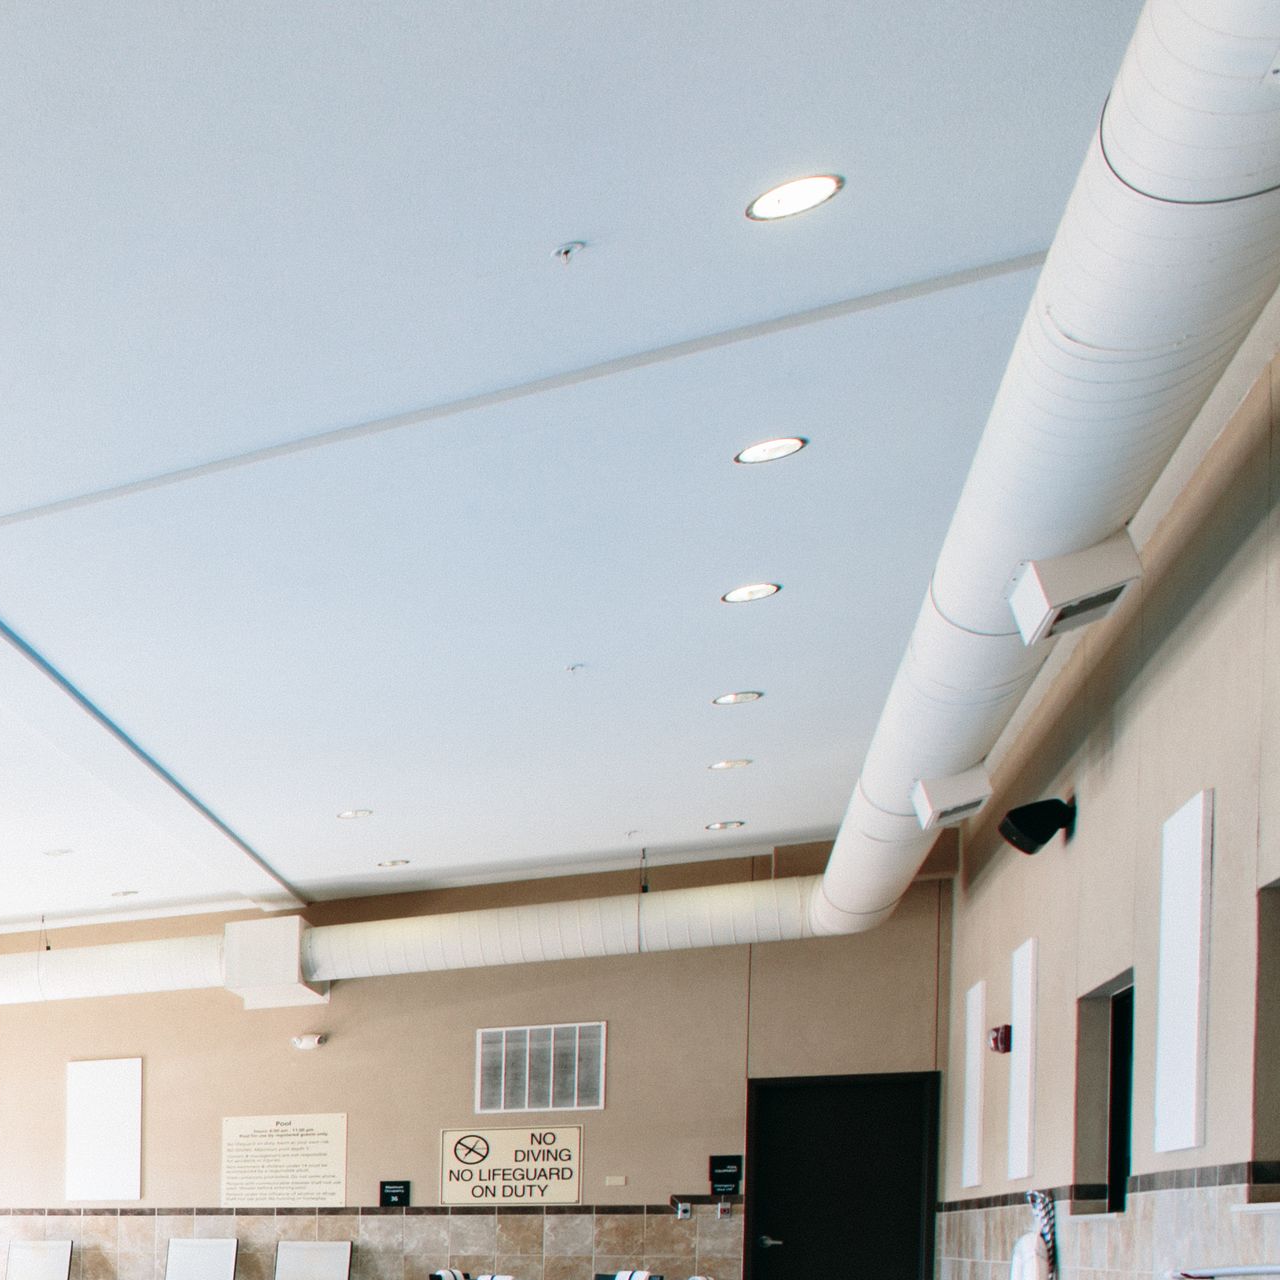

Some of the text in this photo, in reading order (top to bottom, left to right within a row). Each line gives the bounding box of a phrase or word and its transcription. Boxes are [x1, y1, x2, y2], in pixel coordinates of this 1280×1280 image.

[530, 1132, 556, 1146] NO
[515, 1148, 572, 1163] DIVING
[449, 1167, 573, 1182] NO LIFEGUARD
[472, 1184, 548, 1198] ON DUTY
